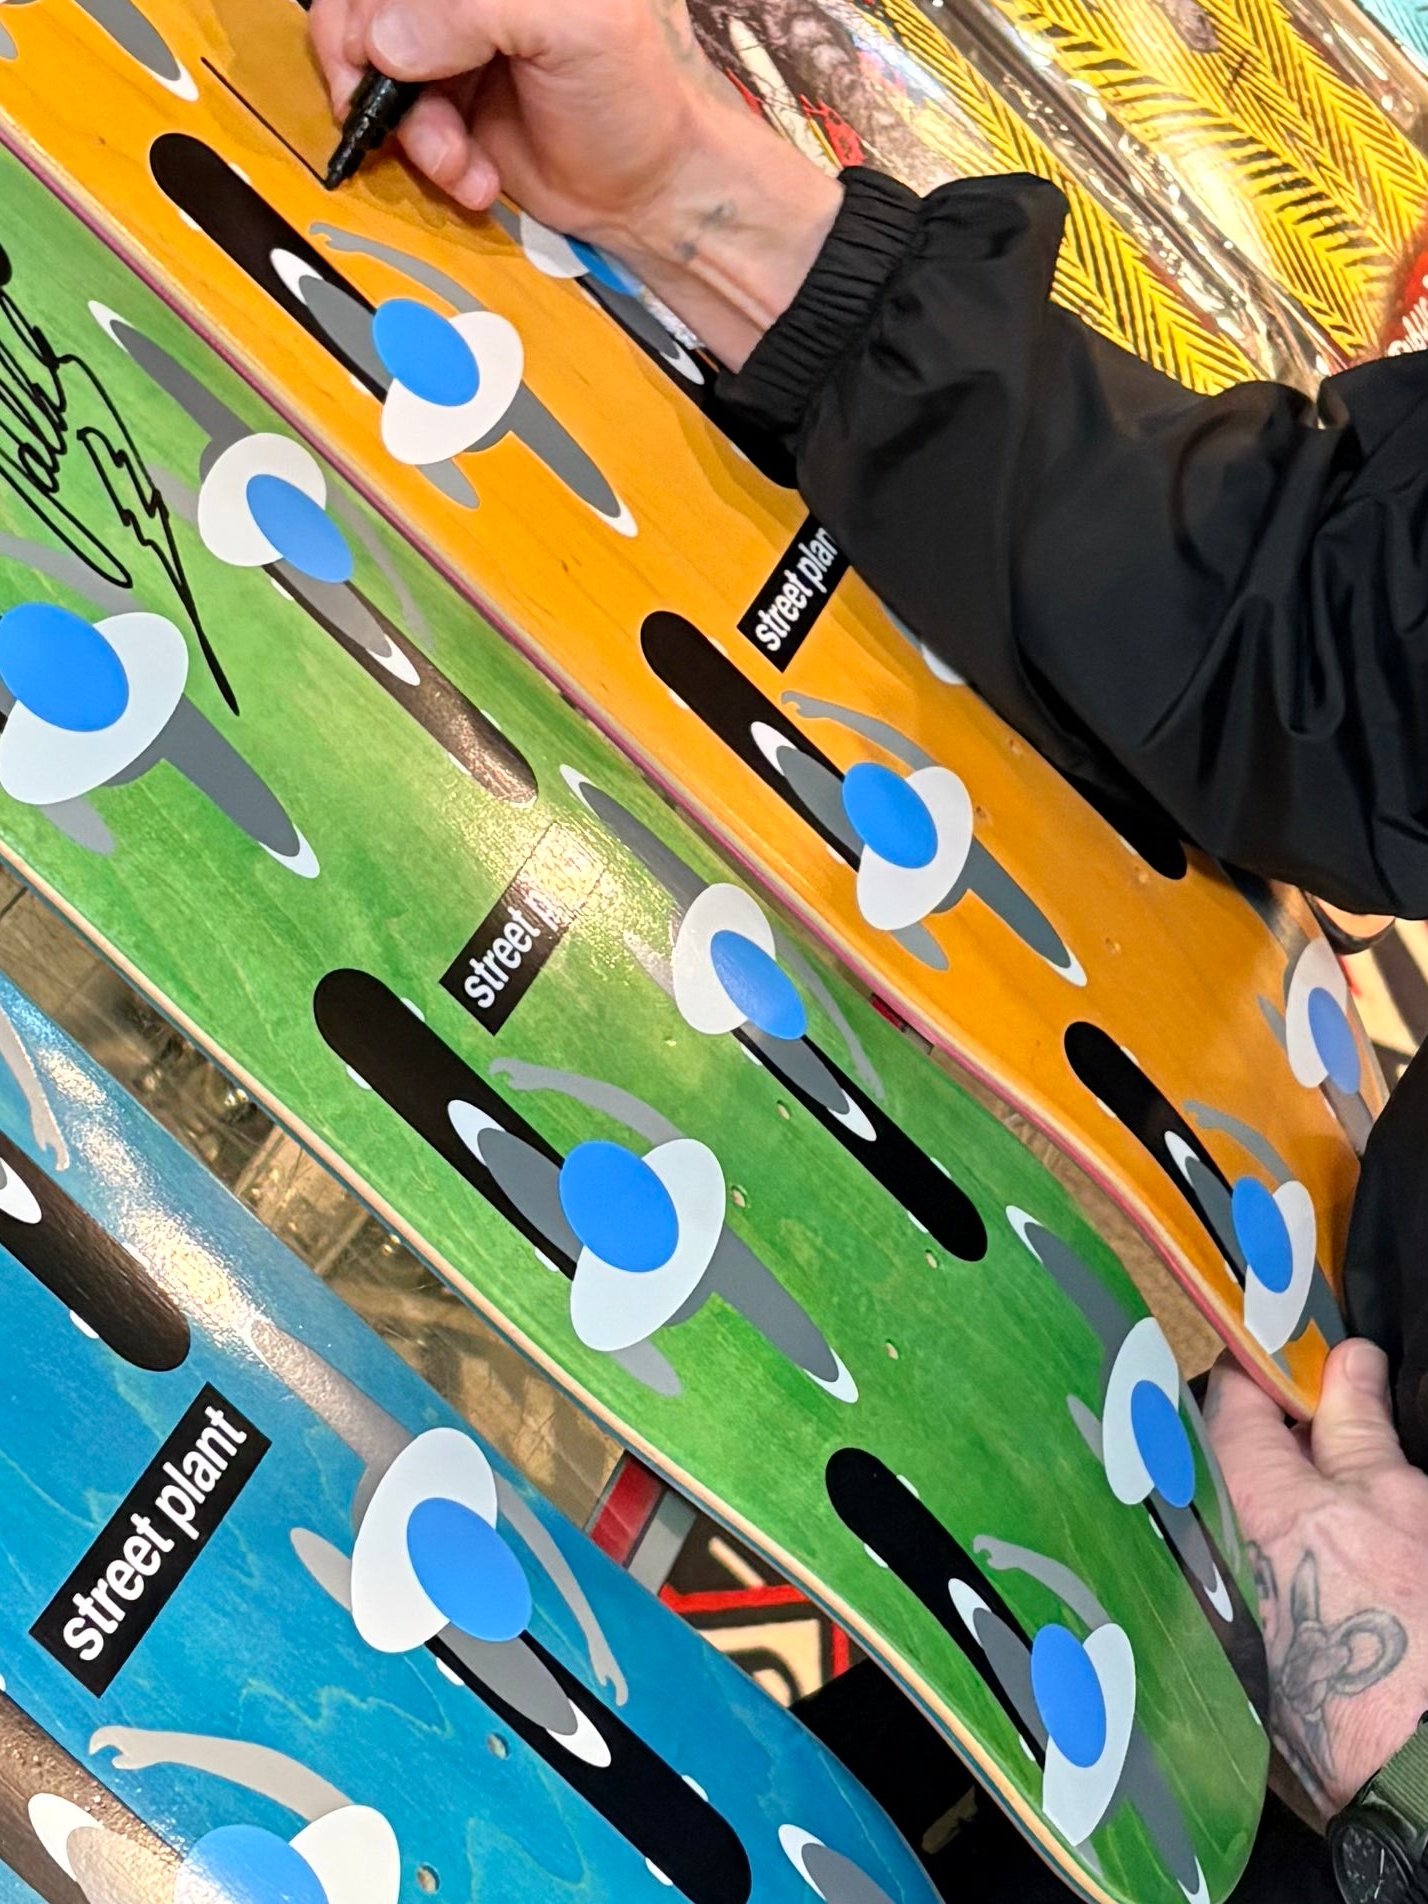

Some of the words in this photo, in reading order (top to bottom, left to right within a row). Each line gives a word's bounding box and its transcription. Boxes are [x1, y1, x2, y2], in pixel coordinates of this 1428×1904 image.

[755, 569, 814, 651] street
[796, 527, 838, 594] plan
[463, 906, 541, 1009] street
[63, 1512, 175, 1661] street
[155, 1405, 247, 1540] plant
